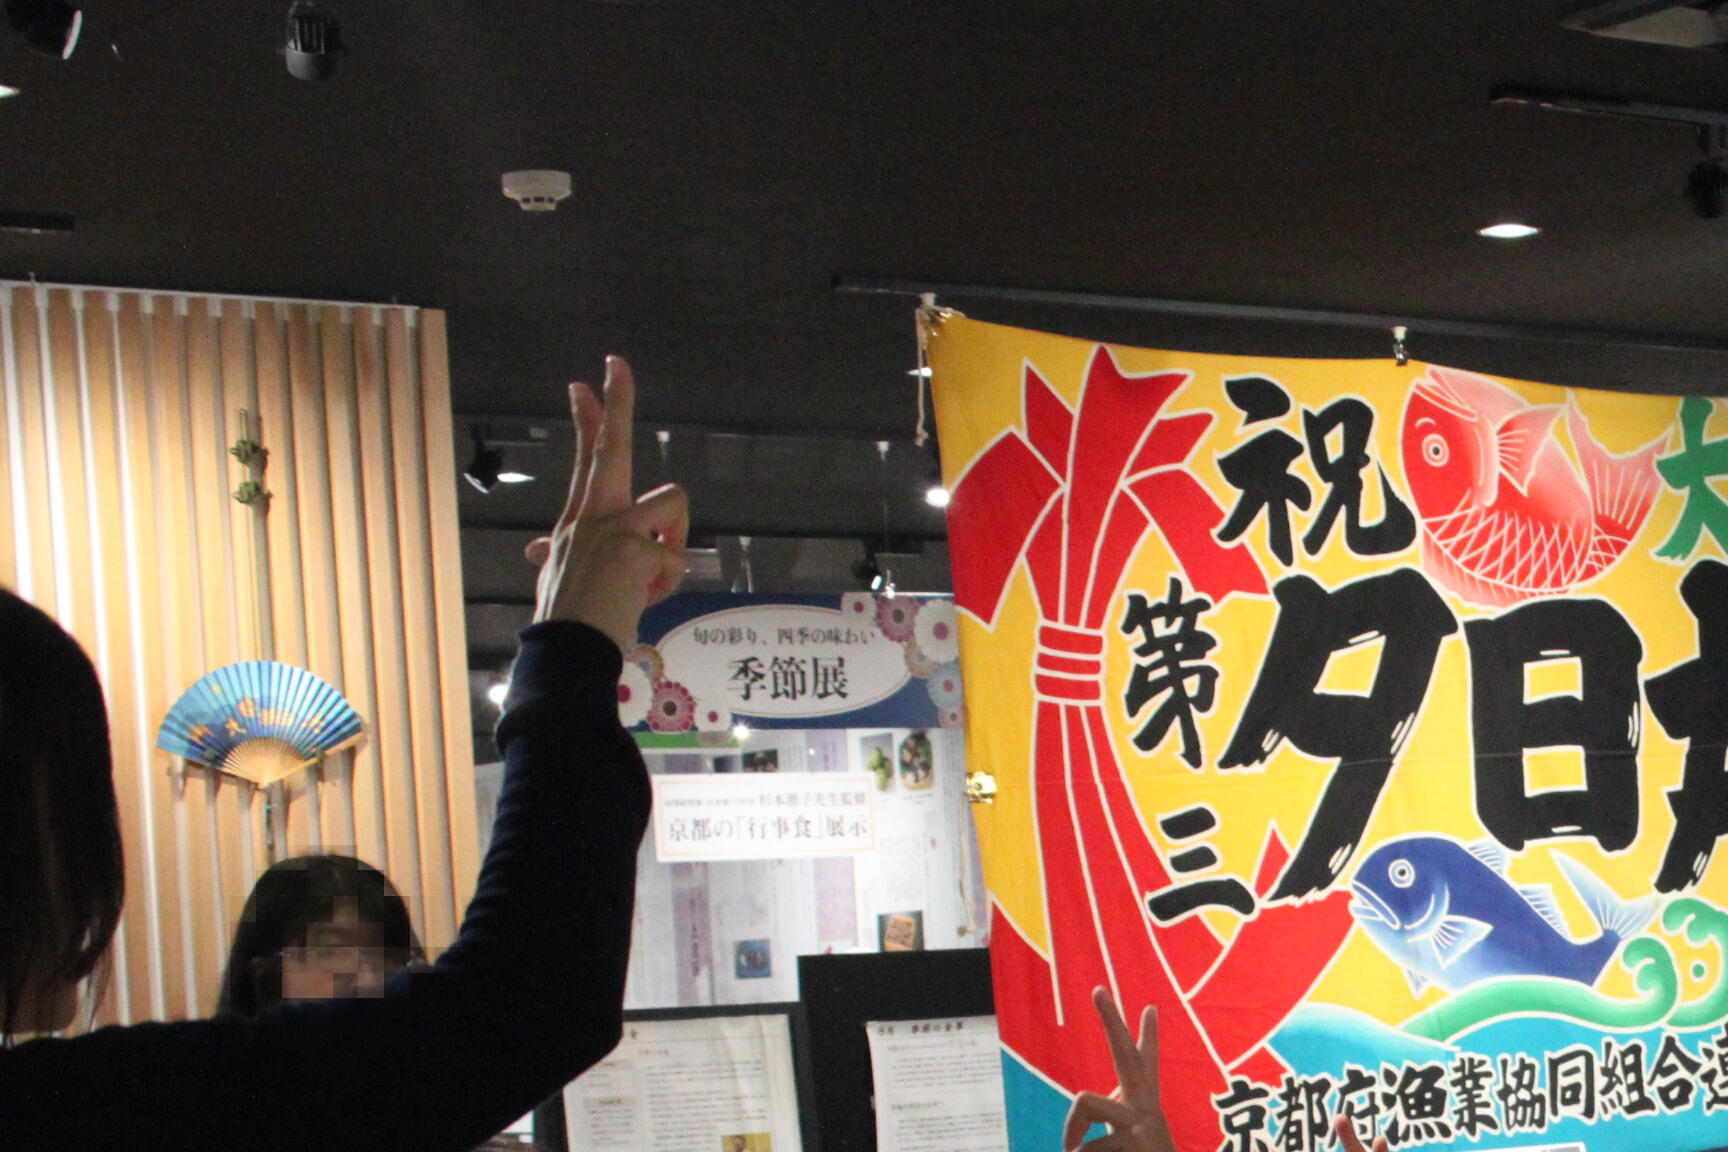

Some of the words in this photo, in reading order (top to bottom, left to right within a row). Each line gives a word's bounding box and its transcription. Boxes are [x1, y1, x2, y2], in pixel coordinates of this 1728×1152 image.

[1215, 377, 1415, 566] 祝
[694, 627, 876, 646] 旬の彩り、四季の味わい
[727, 656, 849, 700] 季節展
[1121, 578, 1257, 924] 第三
[668, 814, 868, 843] 京都の「行事食」展示
